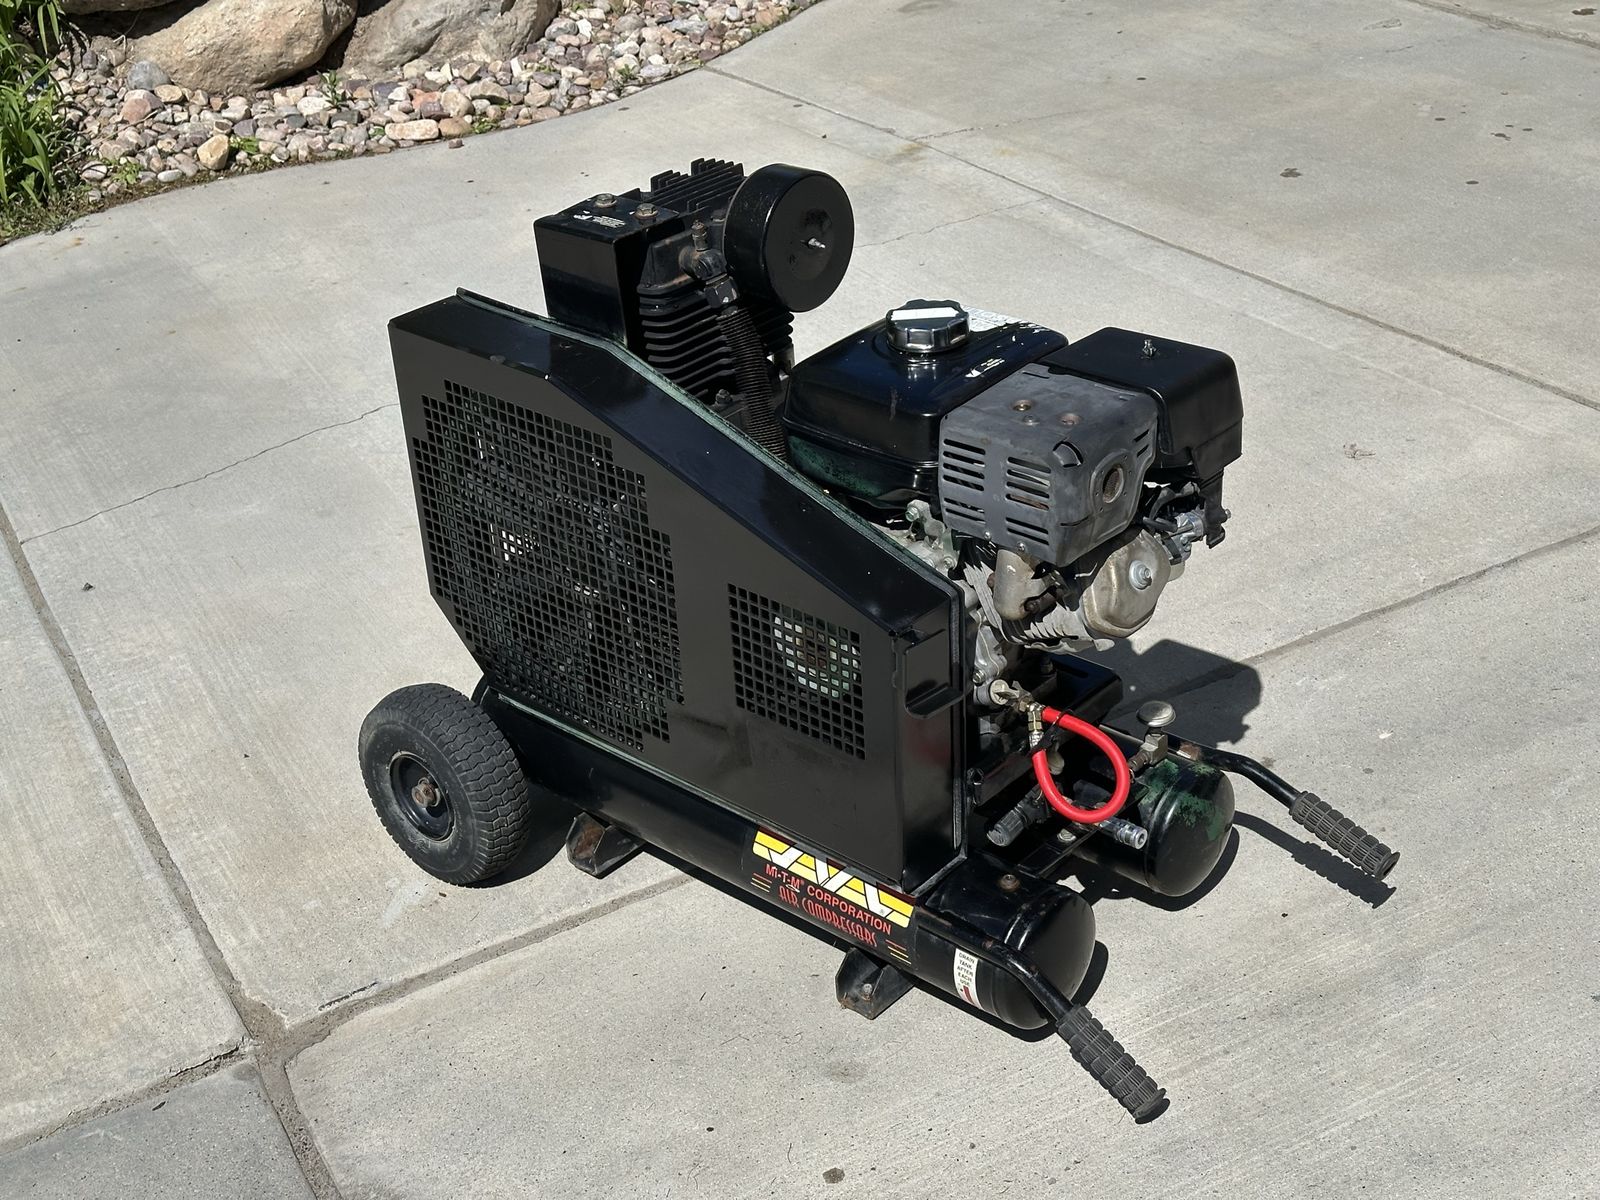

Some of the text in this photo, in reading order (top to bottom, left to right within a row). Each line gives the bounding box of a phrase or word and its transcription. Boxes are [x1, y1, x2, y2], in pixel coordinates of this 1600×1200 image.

[779, 886, 877, 948] AIR COMPRESSORS
[807, 885, 892, 935] CORPORATION
